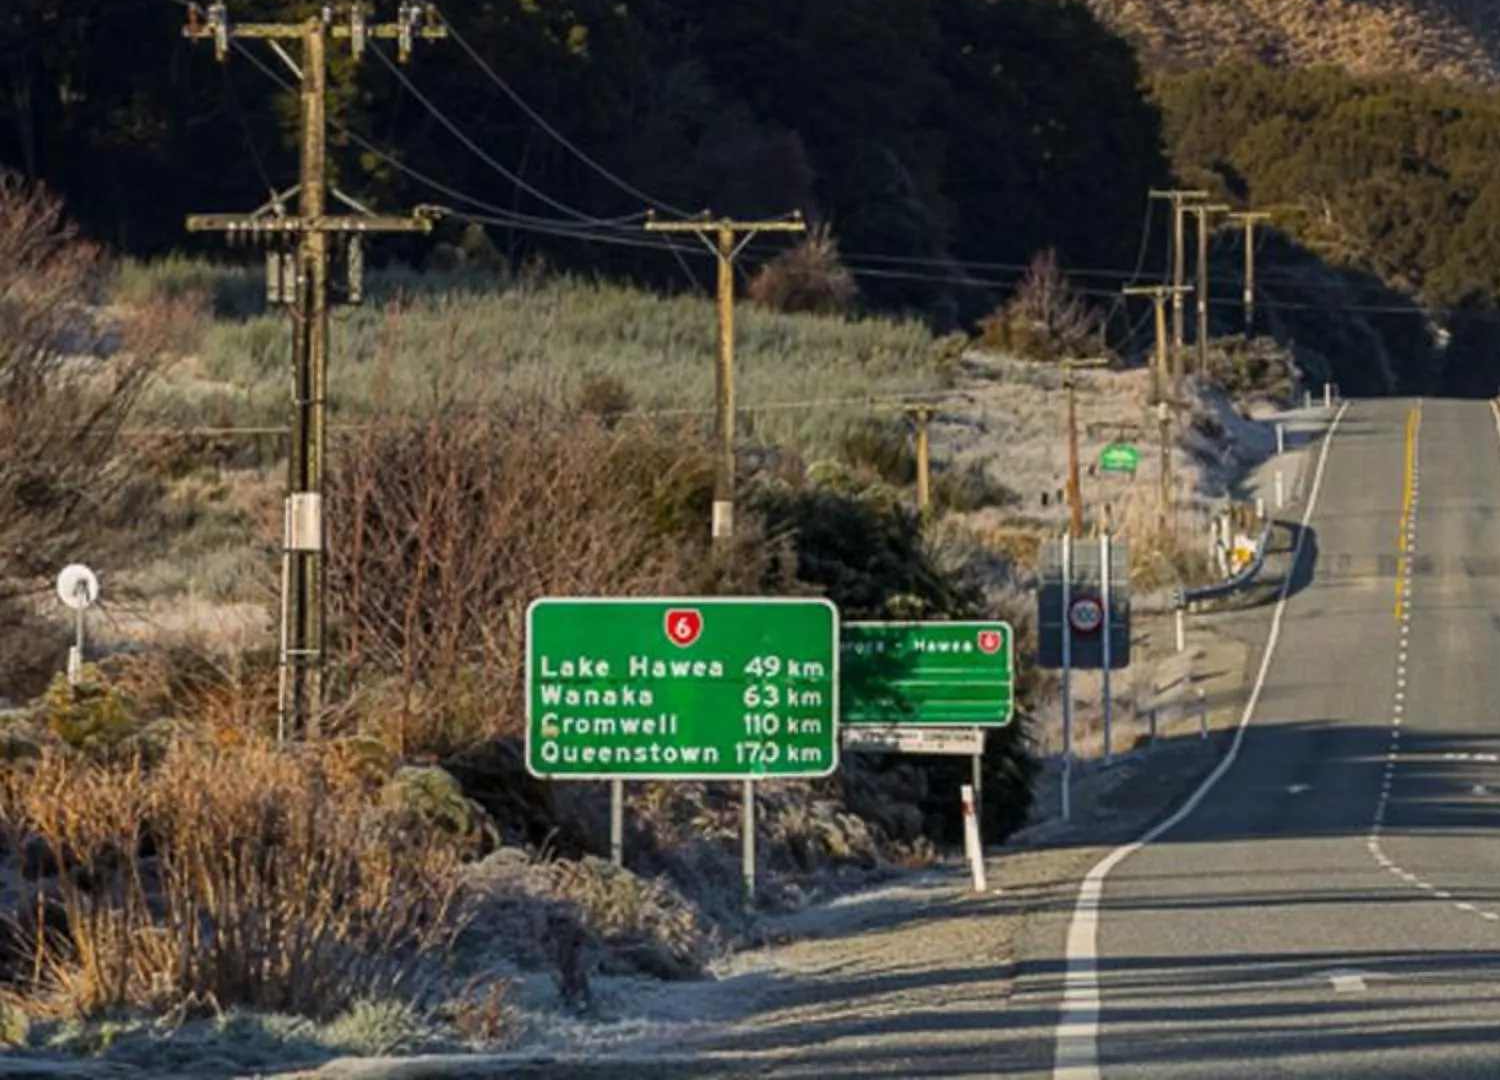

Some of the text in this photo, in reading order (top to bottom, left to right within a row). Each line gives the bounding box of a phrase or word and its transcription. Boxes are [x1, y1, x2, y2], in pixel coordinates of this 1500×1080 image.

[674, 617, 692, 639] 6
[540, 655, 824, 678] Lake Hawea 49 km
[540, 683, 822, 708] Wanaka 63 km
[540, 712, 822, 738] Cromwell 110 km
[540, 740, 822, 764] Queenstown 170 km
